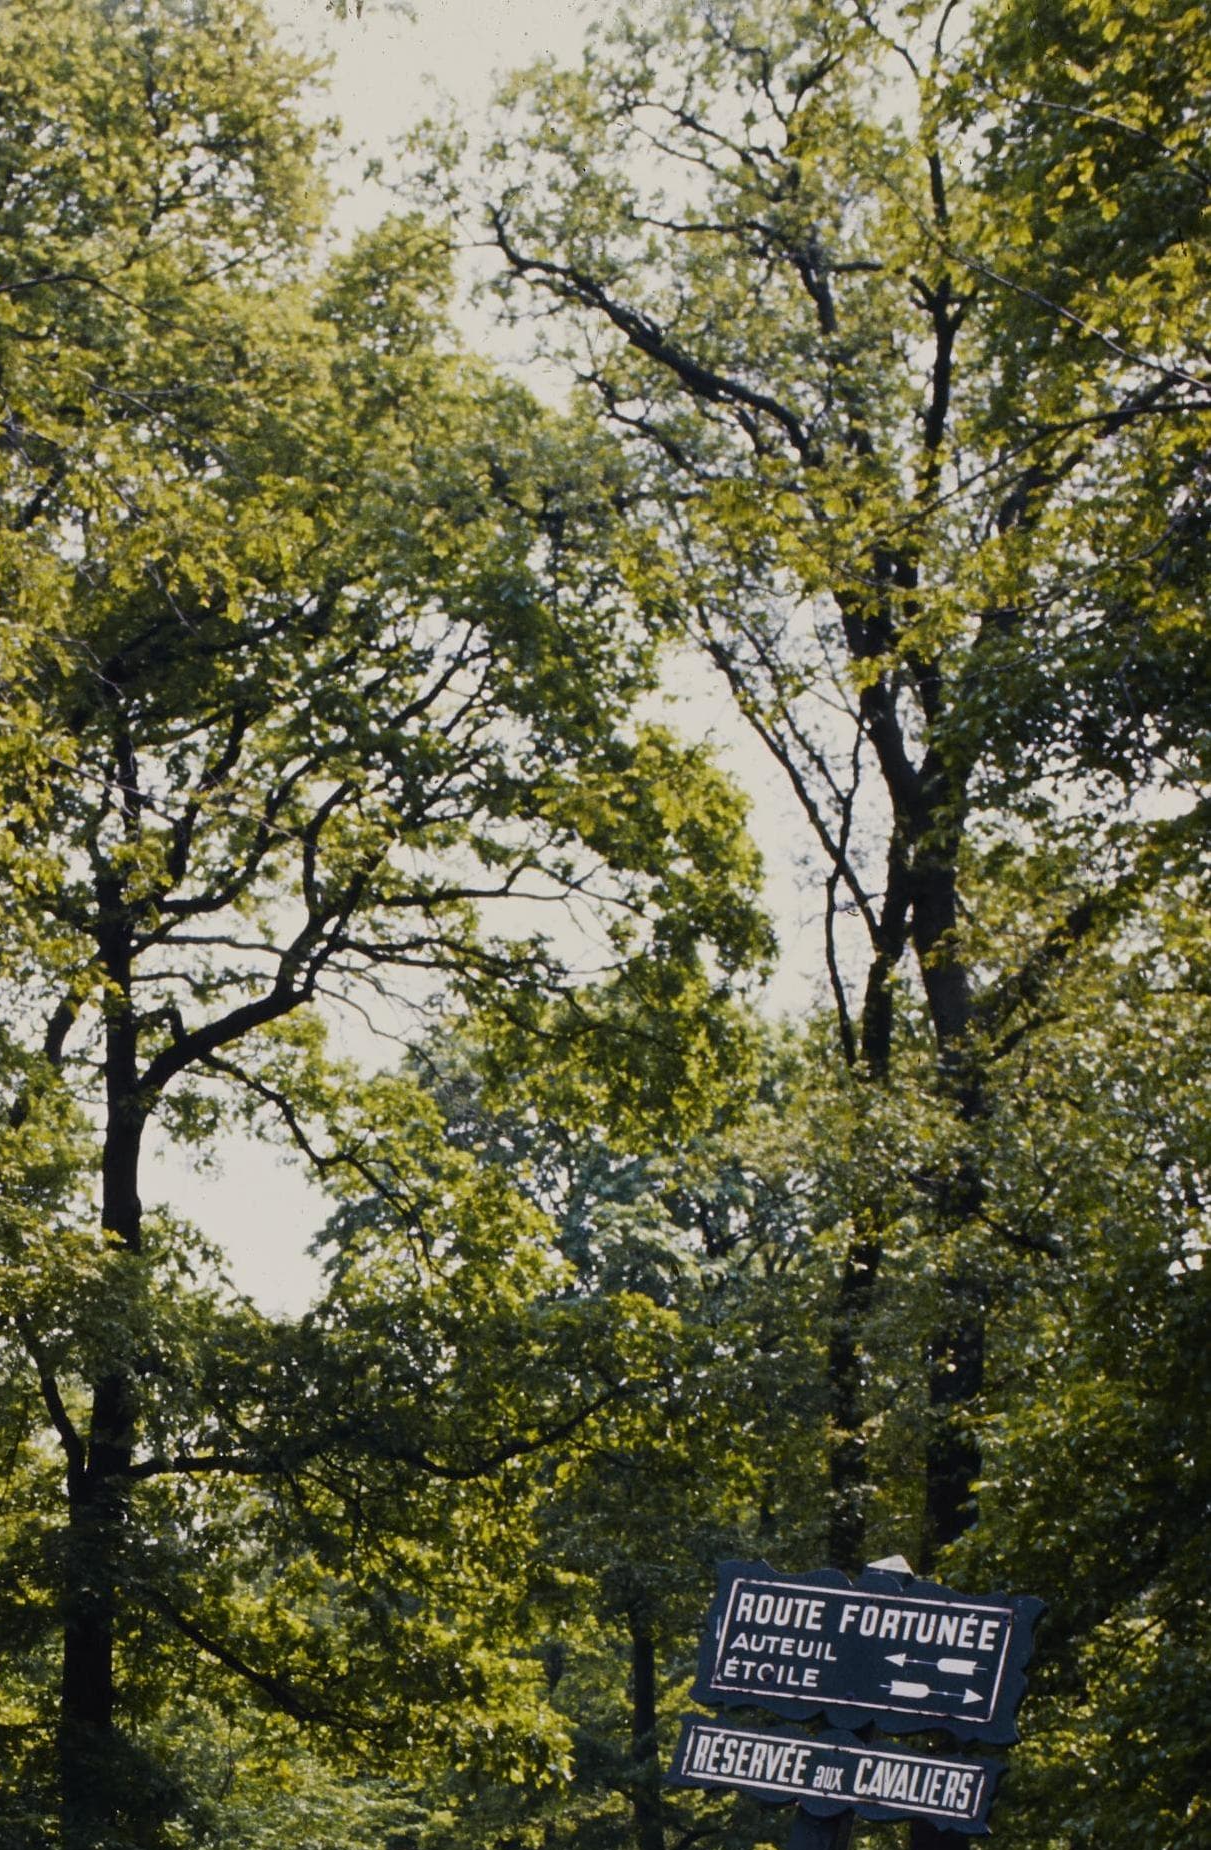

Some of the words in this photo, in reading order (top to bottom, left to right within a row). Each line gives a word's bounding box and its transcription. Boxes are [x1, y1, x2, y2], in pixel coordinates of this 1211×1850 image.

[735, 1592, 826, 1631] ROUTE
[838, 1604, 1000, 1651] FORTUNÉE
[730, 1632, 837, 1661] AUTEUIL
[723, 1657, 820, 1688] ÉTOILE
[693, 1733, 811, 1785] RÉSERVÉE
[813, 1764, 844, 1792] aux
[853, 1758, 974, 1810] CAVALIERS
